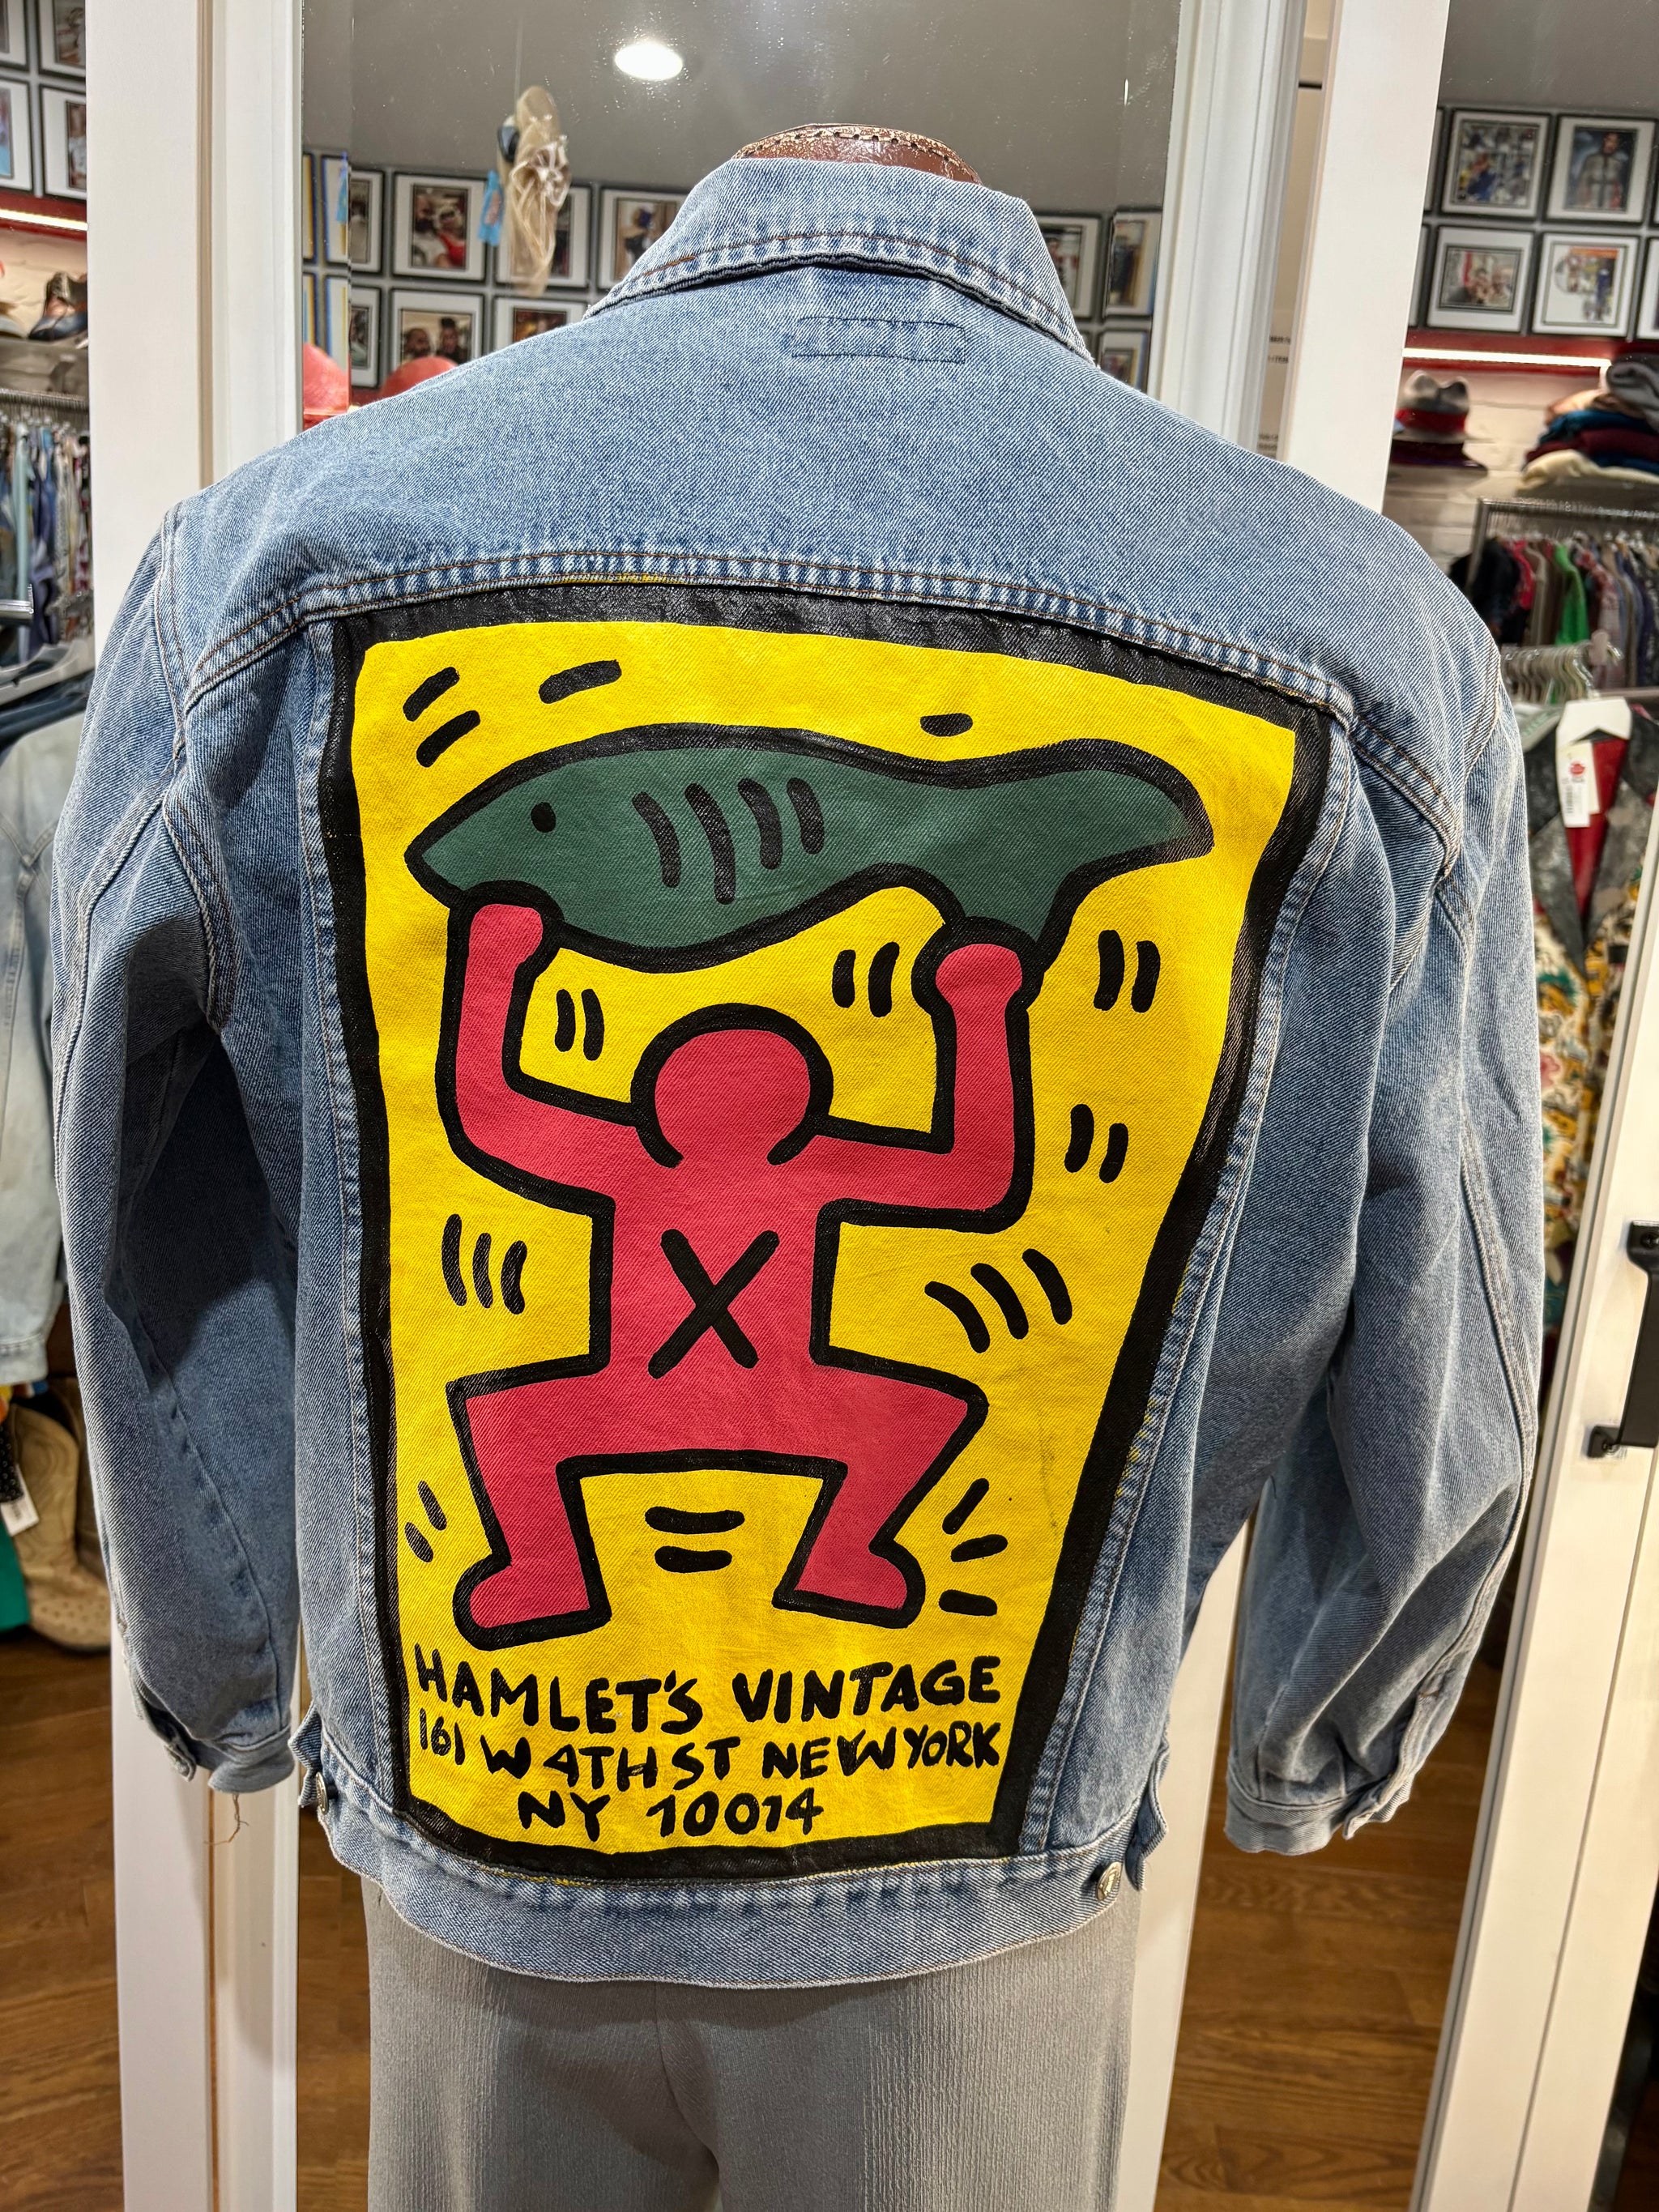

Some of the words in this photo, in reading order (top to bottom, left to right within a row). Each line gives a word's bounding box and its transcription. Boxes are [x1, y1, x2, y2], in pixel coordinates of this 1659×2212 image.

[414, 1643, 702, 1735] HAMLET'S
[732, 1655, 1001, 1724] VINTAGE
[420, 1707, 466, 1766] 161
[480, 1734, 532, 1779] W
[518, 1790, 611, 1843] NY
[646, 1787, 825, 1839] 10014
